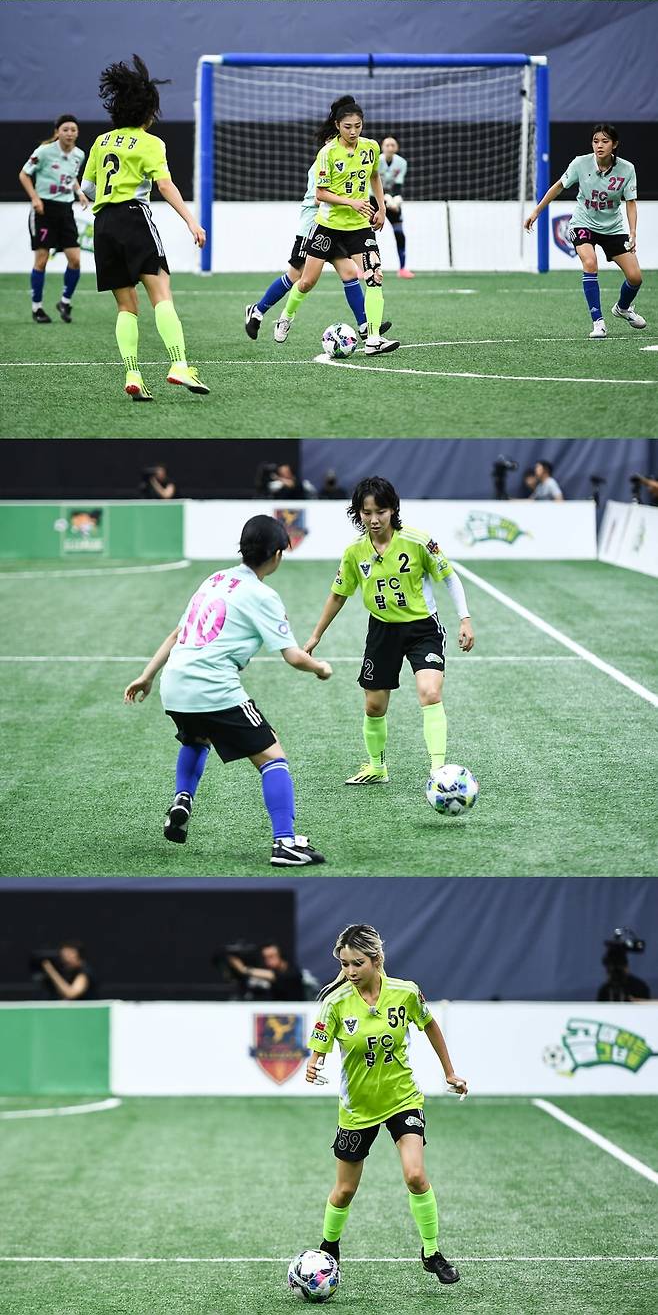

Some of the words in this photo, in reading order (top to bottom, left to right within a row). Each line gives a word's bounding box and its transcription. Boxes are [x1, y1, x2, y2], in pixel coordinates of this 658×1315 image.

[360, 148, 375, 165] 20
[103, 153, 120, 196] 2
[349, 169, 367, 181] FC
[607, 176, 625, 191] 27
[591, 189, 609, 202] FC
[40, 228, 48, 243] 7
[311, 233, 332, 252] 20
[397, 552, 411, 574] 2
[376, 577, 401, 592] FC
[374, 591, 407, 610] 탑걸
[179, 592, 227, 647] 10
[363, 658, 374, 681] 2
[387, 1005, 406, 1029] 59
[314, 1032, 328, 1043] SBS
[366, 1033, 395, 1050] FC
[336, 1128, 363, 1153] 59
